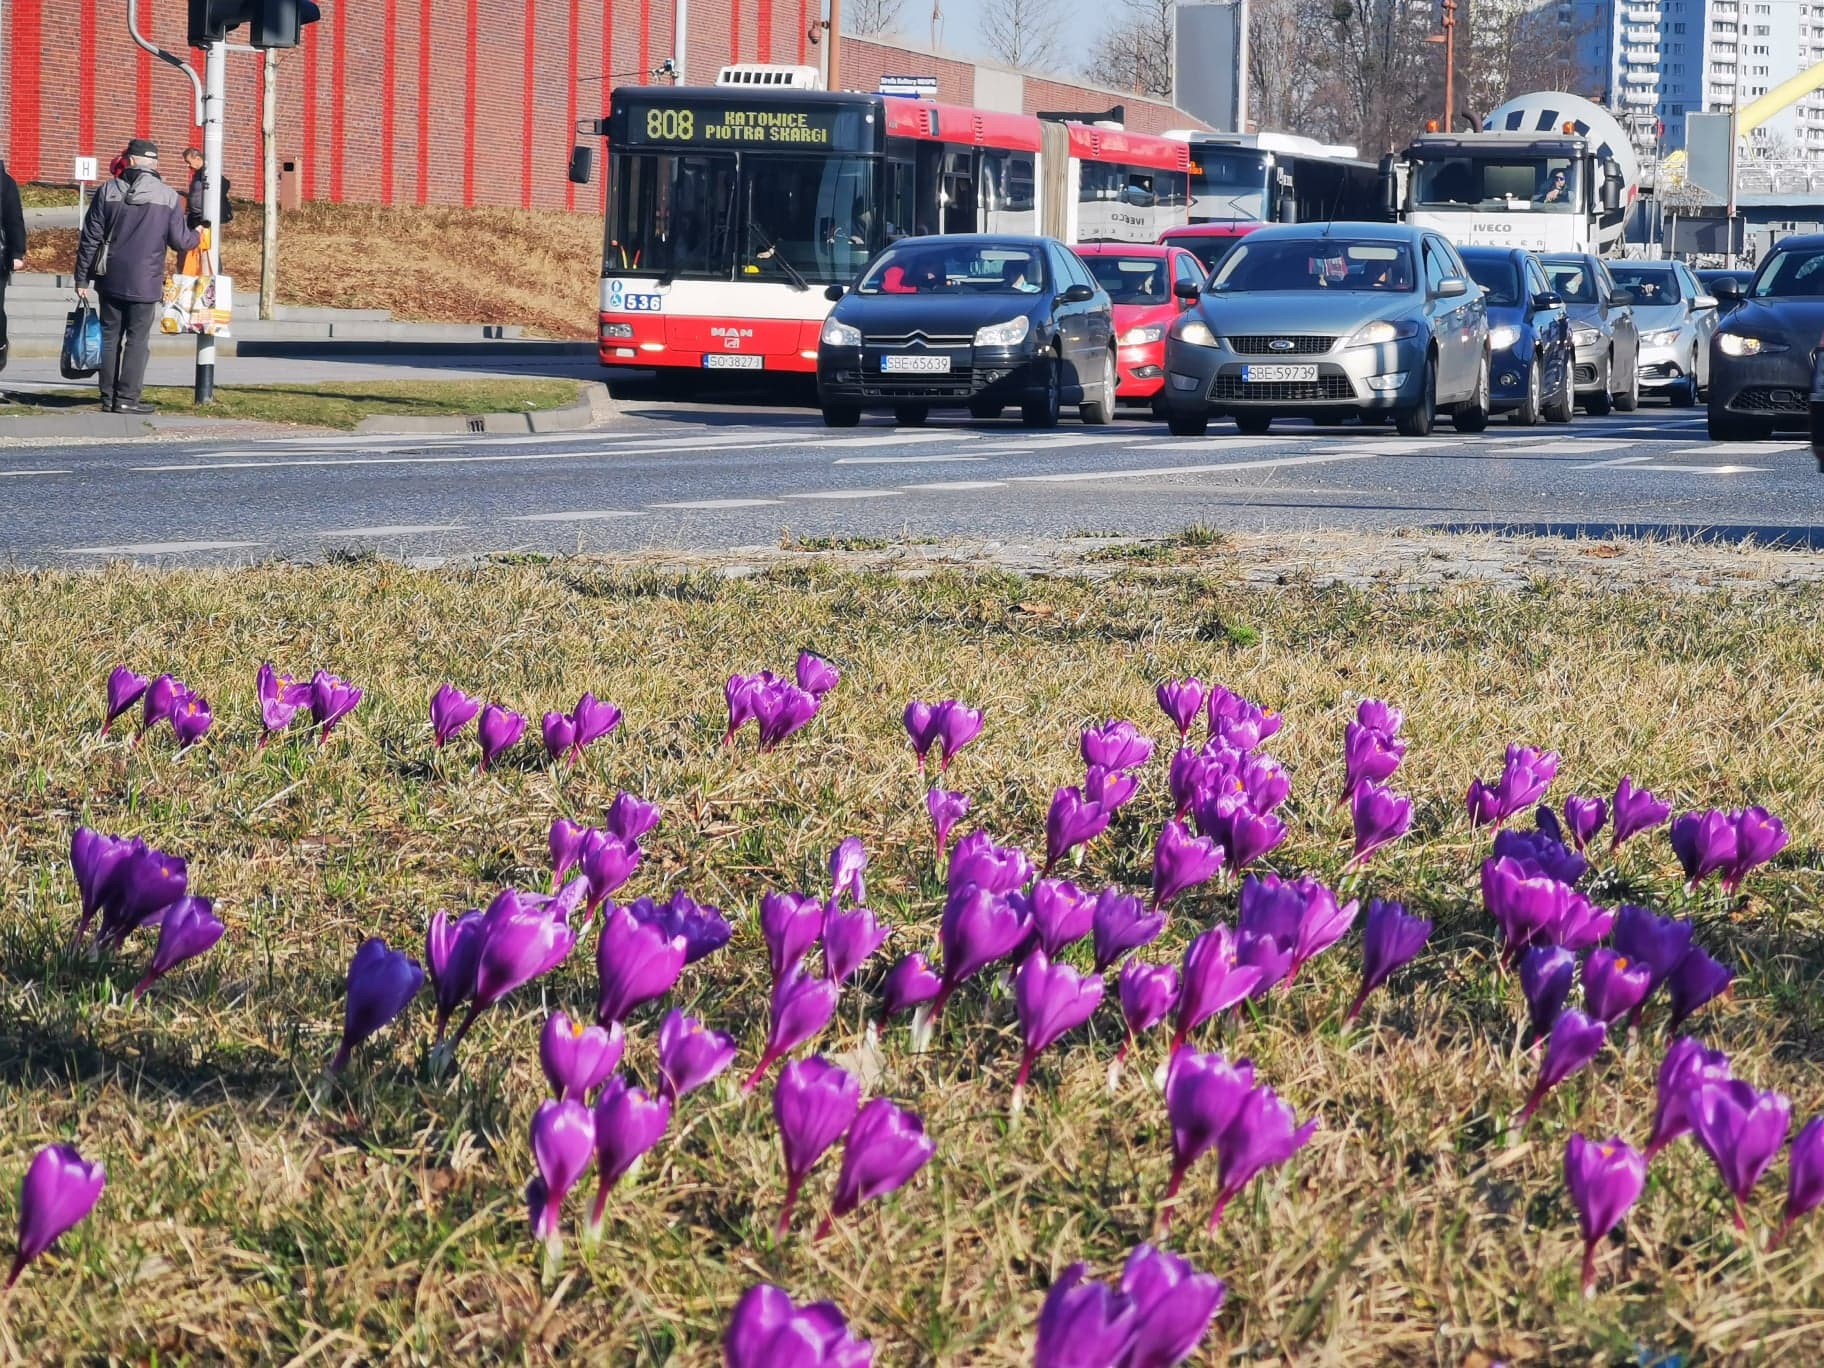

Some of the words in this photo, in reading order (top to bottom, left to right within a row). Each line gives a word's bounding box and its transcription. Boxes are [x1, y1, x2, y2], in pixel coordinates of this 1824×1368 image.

[647, 109, 694, 140] 808
[725, 111, 808, 127] KATOWICE
[705, 125, 765, 140] PIOTRA
[769, 127, 827, 143] SKARGI
[82, 159, 90, 177] H
[1473, 223, 1512, 232] IVECO
[626, 295, 661, 310] 536
[711, 327, 753, 337] MAN
